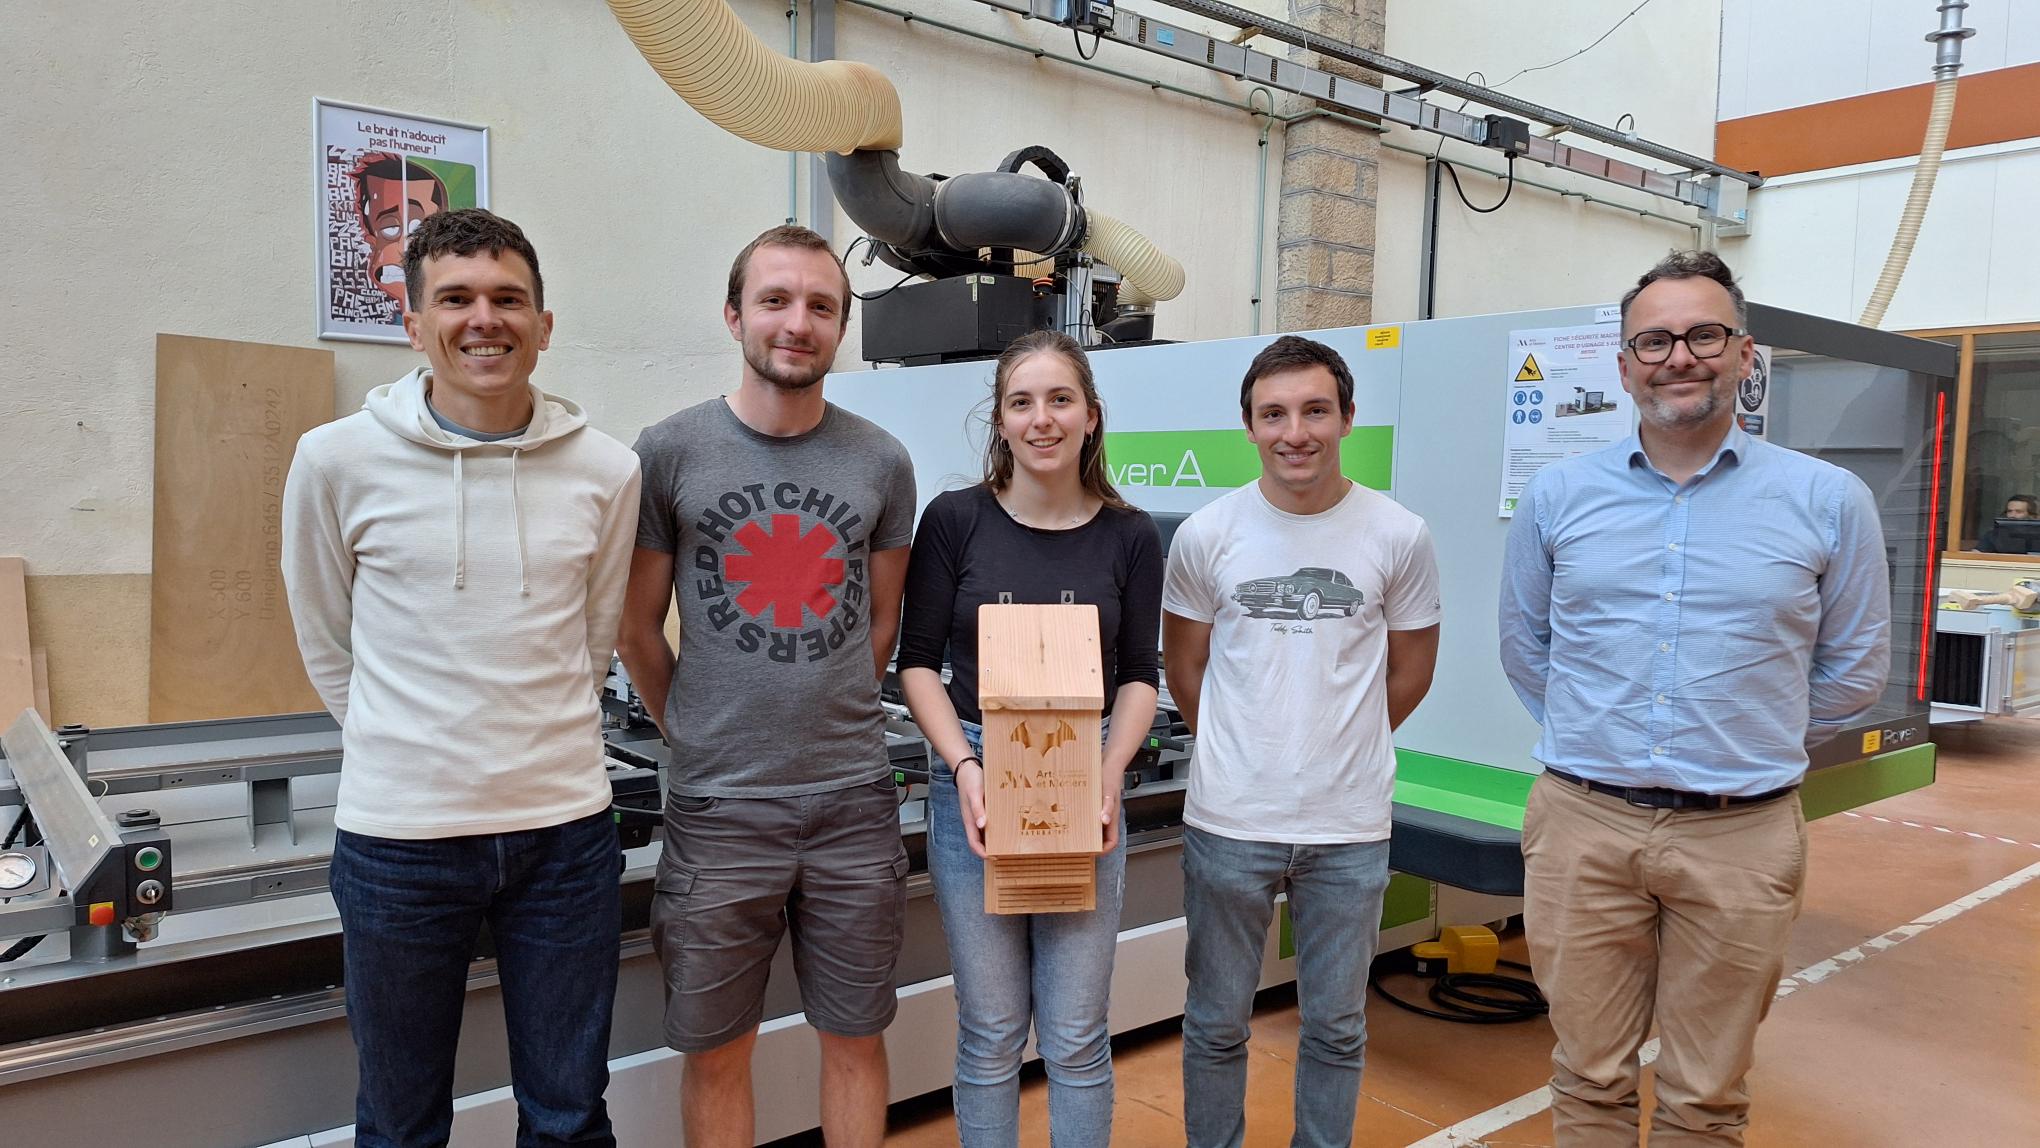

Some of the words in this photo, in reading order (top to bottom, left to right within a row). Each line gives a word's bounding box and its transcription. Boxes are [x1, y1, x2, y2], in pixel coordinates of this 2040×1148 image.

[357, 121, 372, 133] Le
[373, 123, 399, 137] bruit
[401, 128, 446, 145] n'adoucit
[369, 137, 388, 148] pas
[389, 138, 432, 154] l'humeur
[433, 145, 437, 155] !
[1170, 449, 1207, 488] A
[696, 482, 767, 544] HOT
[773, 482, 865, 554] CHILI
[695, 545, 741, 632] RED
[735, 558, 864, 664] PEPPERS
[1290, 624, 1314, 635] Smith
